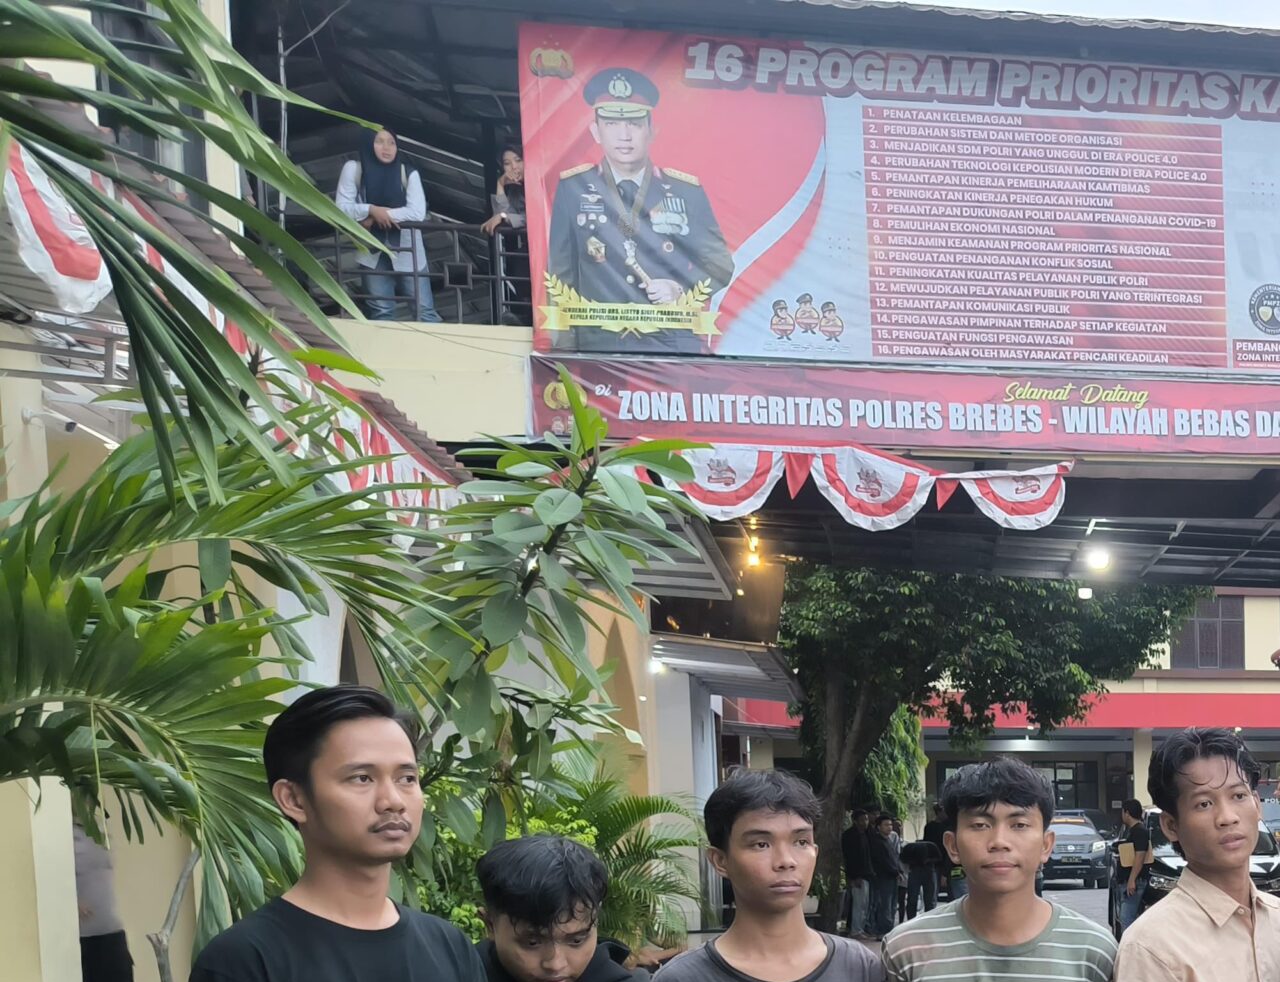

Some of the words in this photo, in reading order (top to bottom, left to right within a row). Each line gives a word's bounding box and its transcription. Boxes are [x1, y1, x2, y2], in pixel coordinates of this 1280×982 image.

[685, 42, 745, 81] 16
[755, 48, 990, 97] PROGRAM
[1001, 63, 1233, 112] PRIORITAS
[884, 109, 941, 120] PENATAAN
[943, 113, 1022, 125] KELEMBAGAAN
[884, 126, 948, 137] PERUBAHAN
[951, 130, 987, 139] SISTEM
[990, 132, 1013, 141] DAN
[1015, 133, 1057, 142] METODE
[1059, 135, 1122, 146] ORGANISASI
[884, 141, 955, 153] MENJADIKAN
[958, 145, 981, 154] SDM
[983, 147, 1012, 156] POLRI
[1015, 149, 1044, 157] YANG
[1047, 149, 1089, 160] UNGGUL
[1091, 152, 1101, 160] DI
[1104, 153, 1122, 161] ERA
[1125, 154, 1160, 163] POLICE
[1162, 156, 1178, 164] 4.0
[871, 157, 880, 165] 4.
[885, 157, 950, 169] PERUBAHAN
[952, 162, 1011, 171] TEKNOLOGI
[1013, 163, 1072, 174] KEPOLISIAN
[1075, 166, 1119, 176] MODERN
[1121, 169, 1131, 177] DI
[1134, 170, 1152, 178] ERA
[1155, 171, 1189, 180] POLICE
[1191, 173, 1207, 181] 4.0
[871, 172, 880, 181] 5.
[886, 173, 959, 185] PEMANTAPAN
[962, 177, 1005, 187] KINERJA
[1007, 179, 1086, 191] PEMELIHARAAN
[1088, 182, 1150, 194] KAMTIBMAS
[872, 188, 880, 196] 6.
[886, 188, 962, 201] PENINGKATAN
[965, 192, 1007, 202] KINERJA
[1010, 195, 1073, 205] PENEGAKAN
[1075, 198, 1113, 207] HUKUM
[872, 204, 880, 212] 7.
[887, 204, 960, 216] PEMANTAPAN
[963, 209, 1023, 218] DUKUNGAN
[1025, 211, 1054, 220] POLRI
[1056, 212, 1093, 221] DALAM
[1095, 214, 1166, 225] PENANGANAN
[1169, 217, 1216, 228] COVID-19
[873, 220, 882, 228] 8.
[888, 220, 948, 231] PEMULIHAN
[951, 223, 1000, 233] EKONOMI
[1002, 226, 1055, 236] NASIONAL
[874, 236, 882, 244] 9.
[888, 236, 946, 247] MENJAMIN
[948, 239, 1008, 249] KEAMANAN
[1011, 241, 1063, 251] PROGRAM
[1066, 244, 1117, 254] PRIORITAS
[1120, 246, 1171, 256] NASIONAL
[874, 252, 887, 260] 10.
[889, 252, 954, 262] PENGUATAN
[956, 255, 1030, 266] PENANGANAN
[1032, 257, 1075, 268] KONFLIK
[1077, 260, 1112, 269] SOSIAL
[875, 267, 885, 275] 11.
[890, 268, 965, 279] PENINGKATAN
[967, 271, 1017, 281] KUALITAS
[1020, 273, 1081, 283] PELAYANAN
[1083, 275, 1117, 285] PUBLIK
[1120, 277, 1148, 286] POLRI
[875, 283, 888, 291] 12.
[891, 283, 969, 294] MEWUJUDKAN
[972, 287, 1031, 297] PELAYANAN
[1034, 289, 1068, 298] PUBLIK
[1071, 291, 1099, 300] POLRI
[1102, 291, 1131, 300] YANG
[1133, 292, 1202, 303] TERINTEGRASI
[876, 299, 889, 307] 13.
[891, 299, 965, 310] PEMANTAPAN
[967, 302, 1033, 313] KOMUNIKASI
[1035, 303, 1070, 314] PUBLIK
[877, 314, 890, 323] 14.
[892, 315, 968, 326] PENGAWASAN
[970, 318, 1021, 328] PIMPINAN
[1023, 320, 1077, 330] TERHADAP
[1080, 321, 1113, 331] SETIAP
[1116, 322, 1166, 333] KEGIATAN
[878, 330, 891, 338] 15.
[893, 330, 957, 341] PENGUATAN
[959, 333, 997, 342] FUNGSI
[999, 336, 1073, 345] PENGAWASAN
[878, 346, 891, 354] 16.
[893, 346, 969, 357] PENGAWASAN
[971, 349, 997, 358] OLEH
[1000, 350, 1073, 360] MASYARAKAT
[1074, 352, 1117, 361] PENCARI
[1119, 353, 1168, 363] KEADILAN
[1237, 353, 1260, 361] ZONA
[1003, 381, 1076, 403] Selamat
[1080, 383, 1149, 409] Datang
[618, 390, 687, 422] ZONA
[693, 393, 844, 426] INTEGRITAS
[850, 399, 943, 430] POLRES
[949, 403, 1042, 433] BREBES
[1062, 406, 1168, 435] WILAYAH
[1174, 408, 1250, 437] BEBAS
